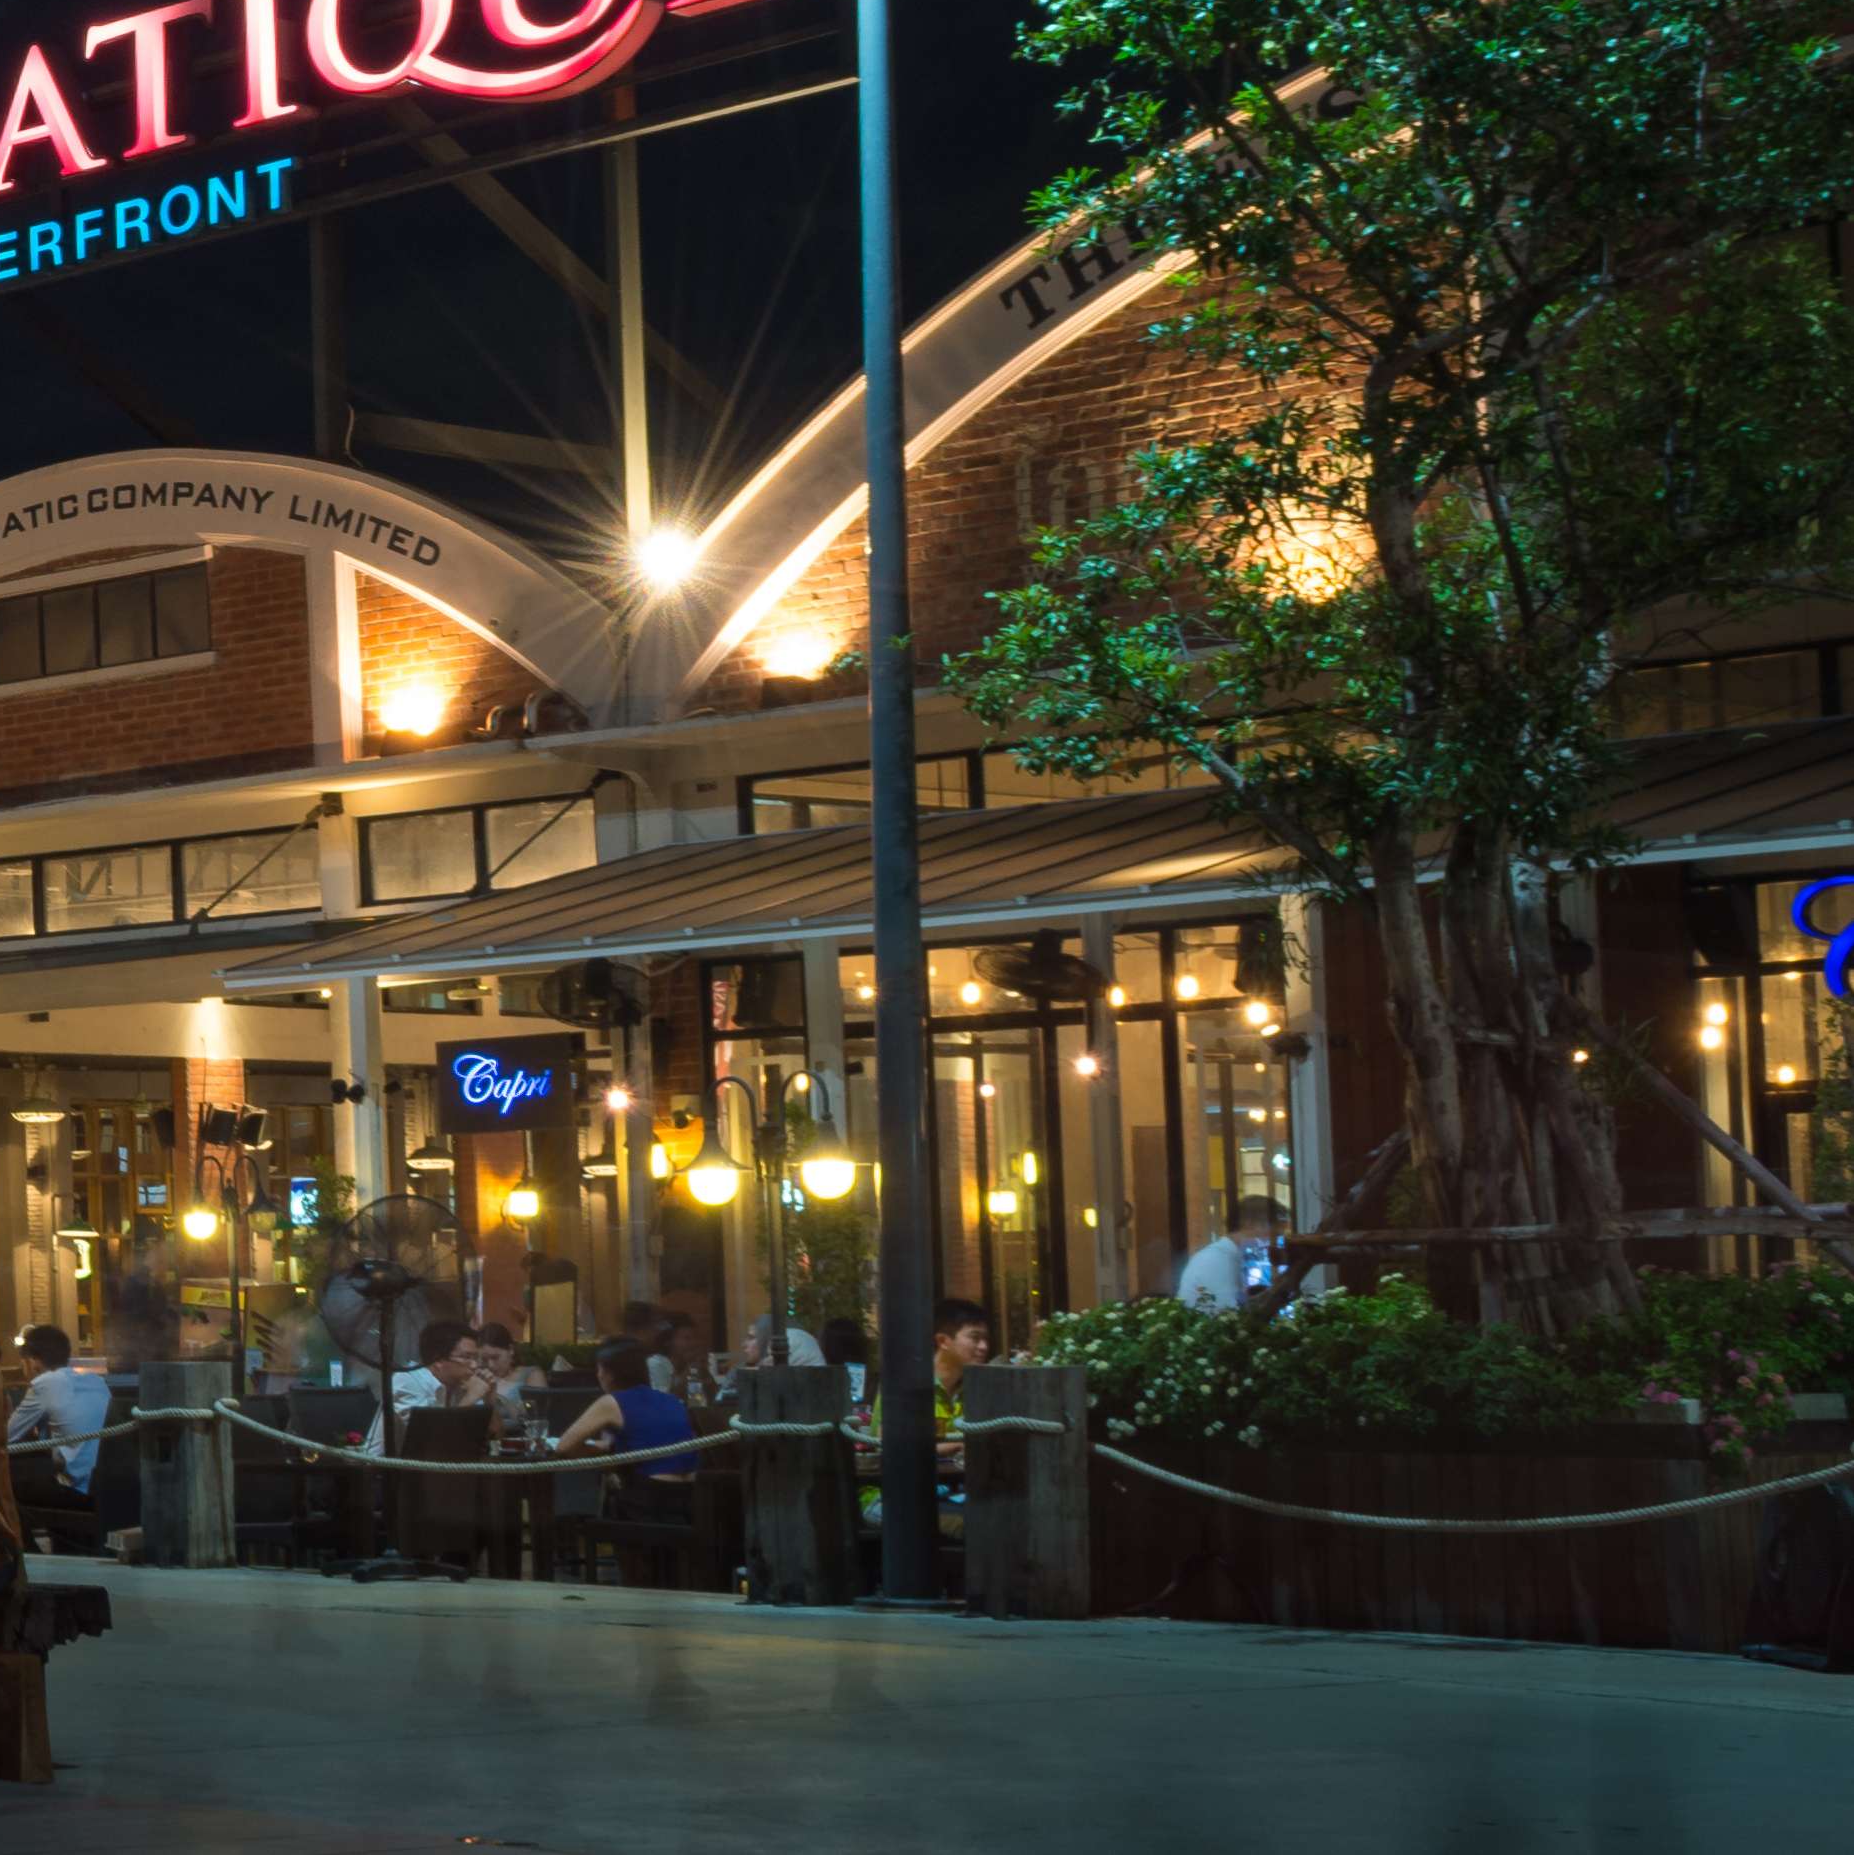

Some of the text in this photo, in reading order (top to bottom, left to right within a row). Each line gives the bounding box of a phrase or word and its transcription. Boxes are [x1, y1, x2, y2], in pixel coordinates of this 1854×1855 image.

[86, 482, 274, 515] COMPANY
[288, 494, 441, 567] LIMITED
[454, 1054, 551, 1114] Capri
